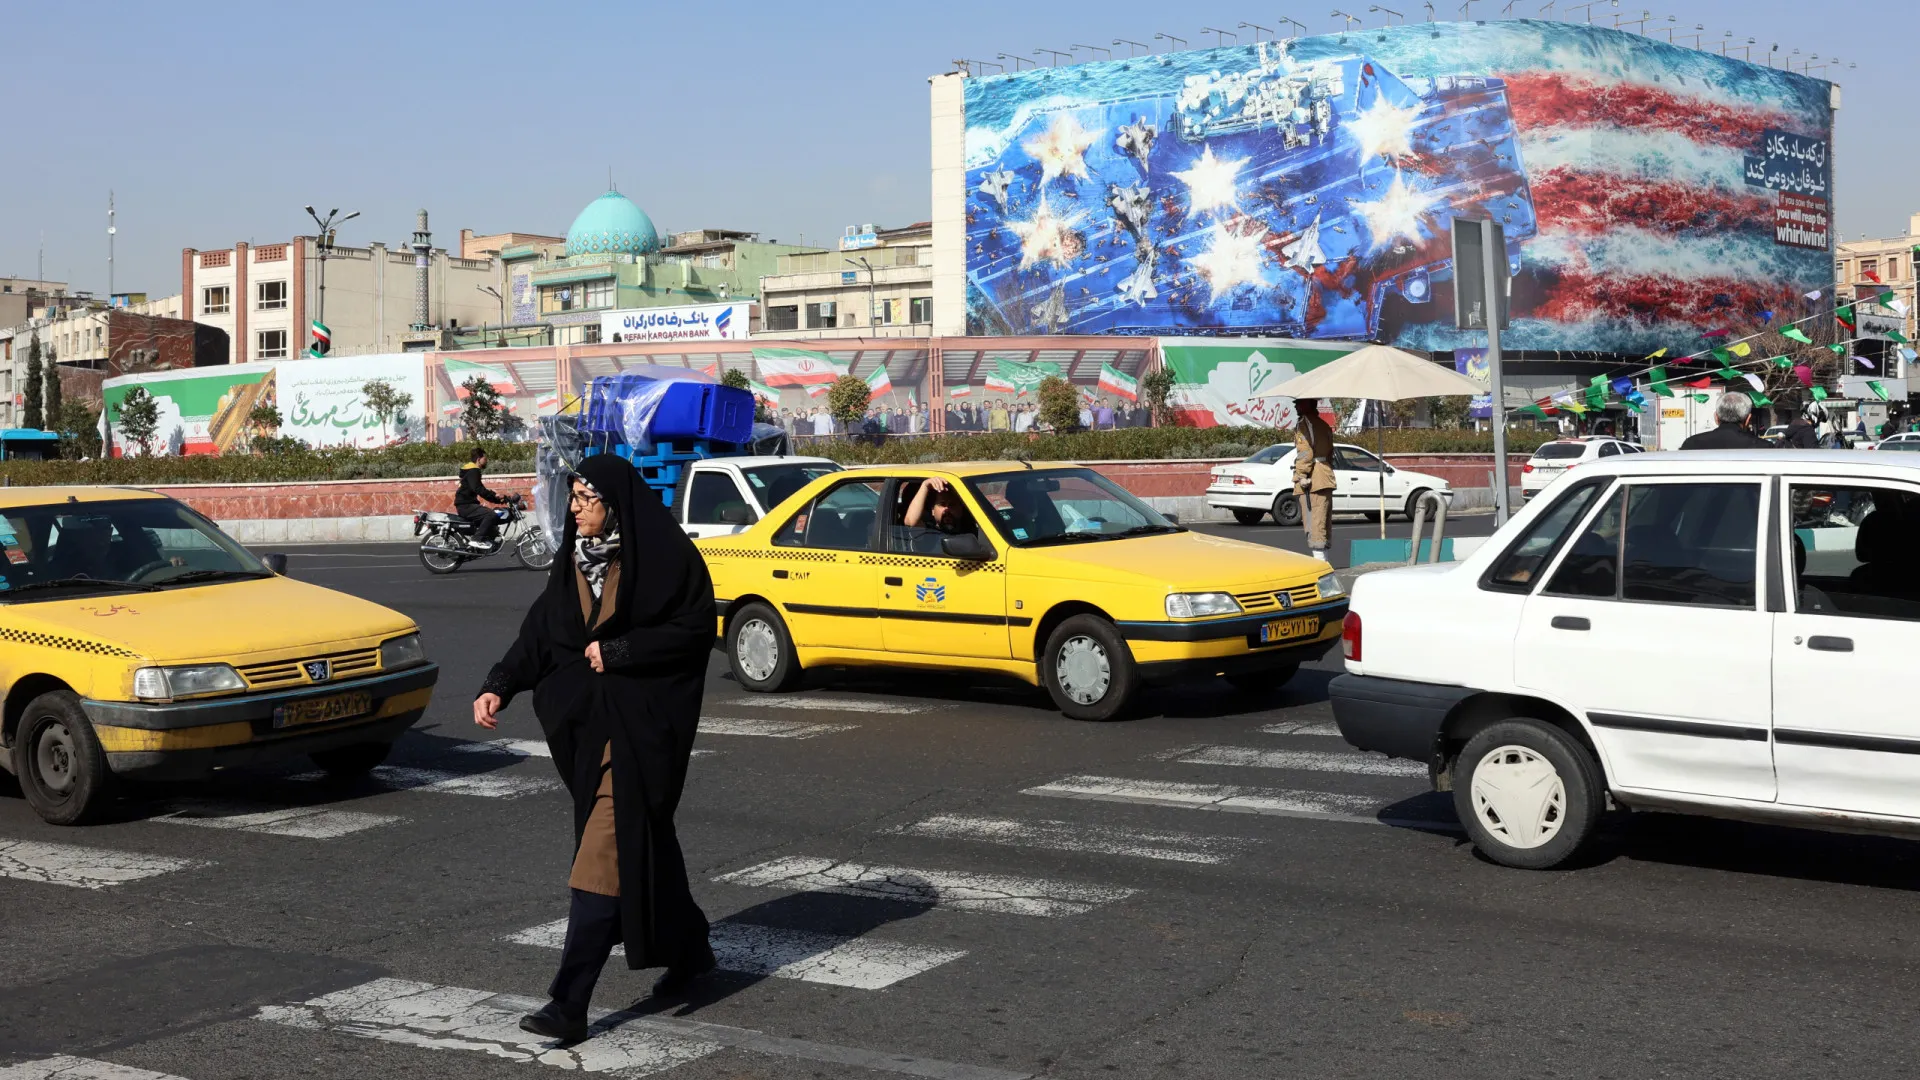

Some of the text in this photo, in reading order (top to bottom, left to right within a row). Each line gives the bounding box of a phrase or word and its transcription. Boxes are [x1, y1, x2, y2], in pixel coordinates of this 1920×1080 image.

[1766, 134, 1789, 161] بکارد
[1790, 139, 1805, 165] باد
[1795, 168, 1825, 195] طوفان
[1785, 197, 1795, 206] you
[1806, 199, 1815, 209] the
[1776, 208, 1827, 227] you will reap the
[1776, 222, 1827, 248] whirlwind
[623, 311, 709, 330] بانک رفاه کارگران
[623, 329, 710, 341] REFAH KARGARAN BANK
